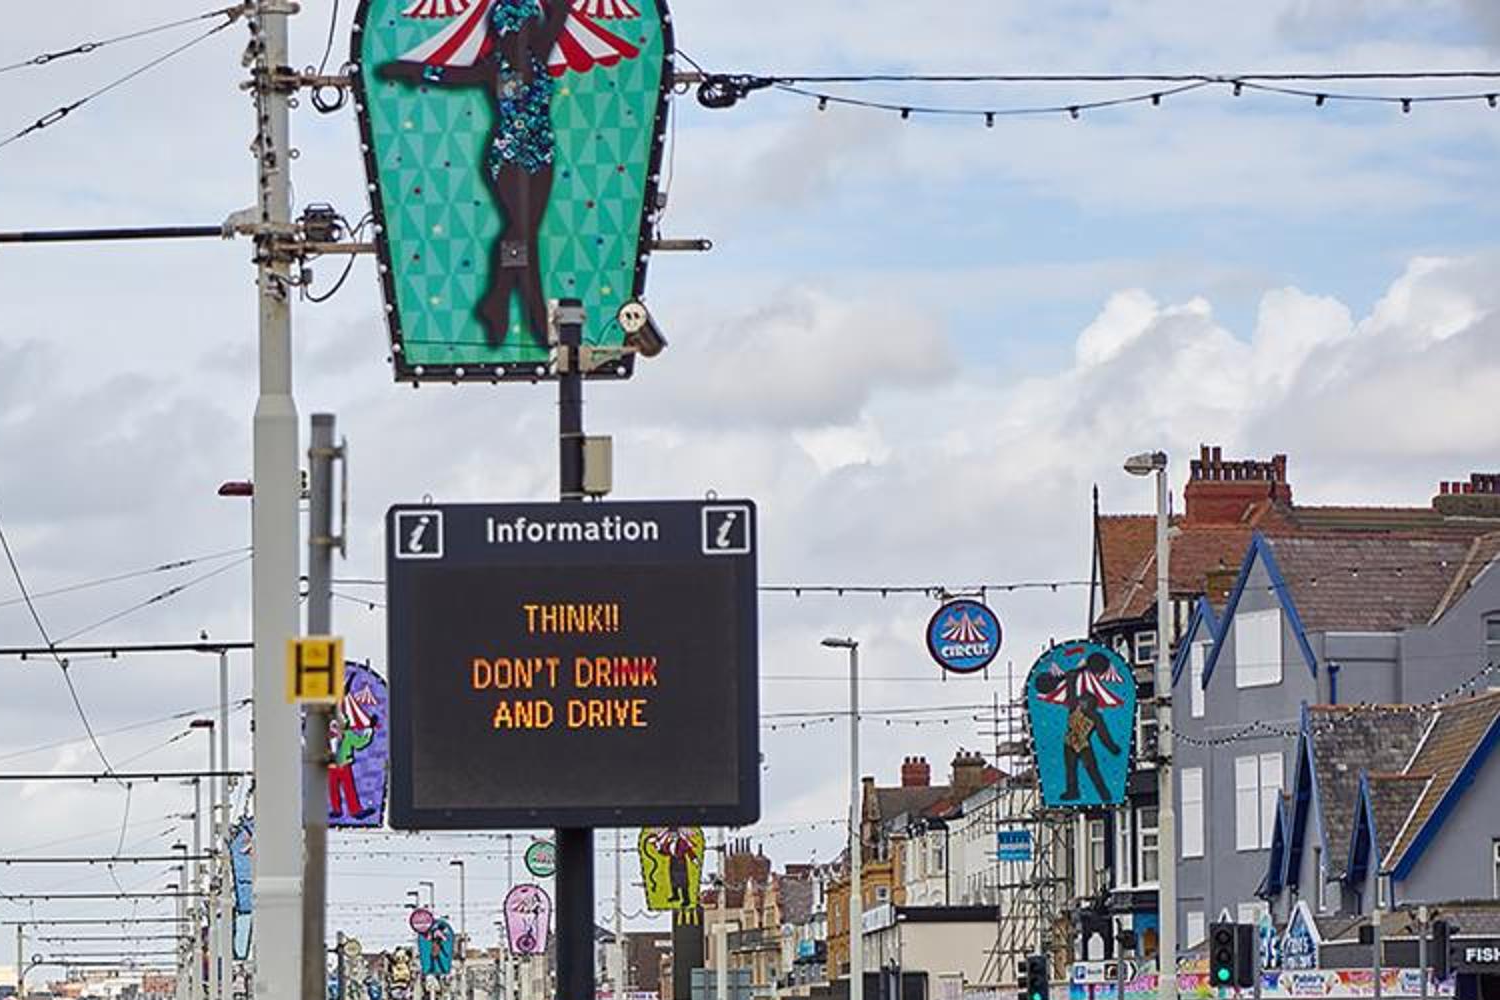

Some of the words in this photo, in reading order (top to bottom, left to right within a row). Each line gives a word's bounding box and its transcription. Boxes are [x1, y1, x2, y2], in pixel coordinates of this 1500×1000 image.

[486, 516, 660, 544] Information
[523, 604, 619, 632] THINK!!
[941, 643, 990, 658] CIRCUS
[295, 643, 335, 696] H
[473, 656, 560, 689] DON'T
[574, 656, 658, 688] DRINK
[493, 700, 554, 729] AND
[567, 699, 648, 728] DRIVE
